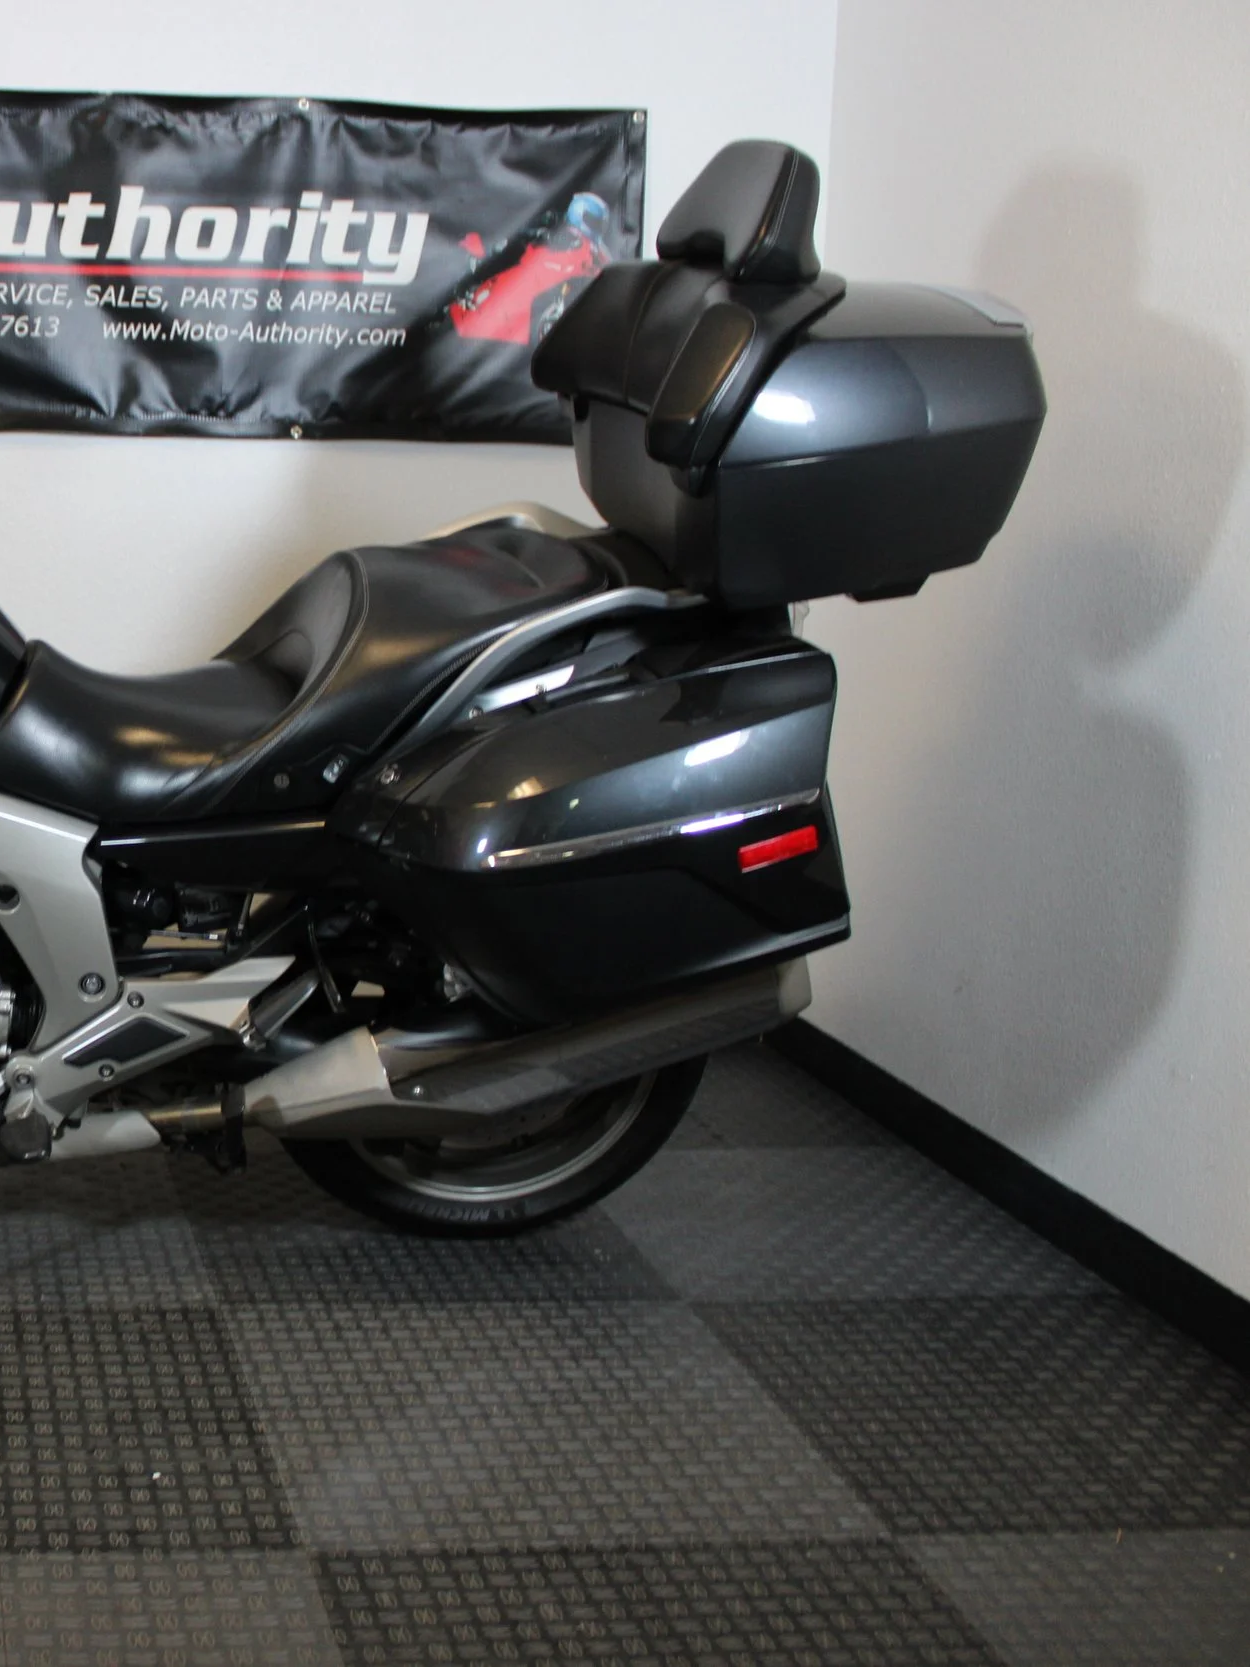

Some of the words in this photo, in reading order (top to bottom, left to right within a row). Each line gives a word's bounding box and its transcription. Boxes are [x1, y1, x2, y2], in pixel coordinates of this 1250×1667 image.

[84, 285, 169, 312] SALES,
[180, 287, 259, 310] PARTS
[266, 289, 283, 311] &
[290, 291, 397, 314] APPAREL
[102, 318, 407, 349] www.Moto-Authority.com
